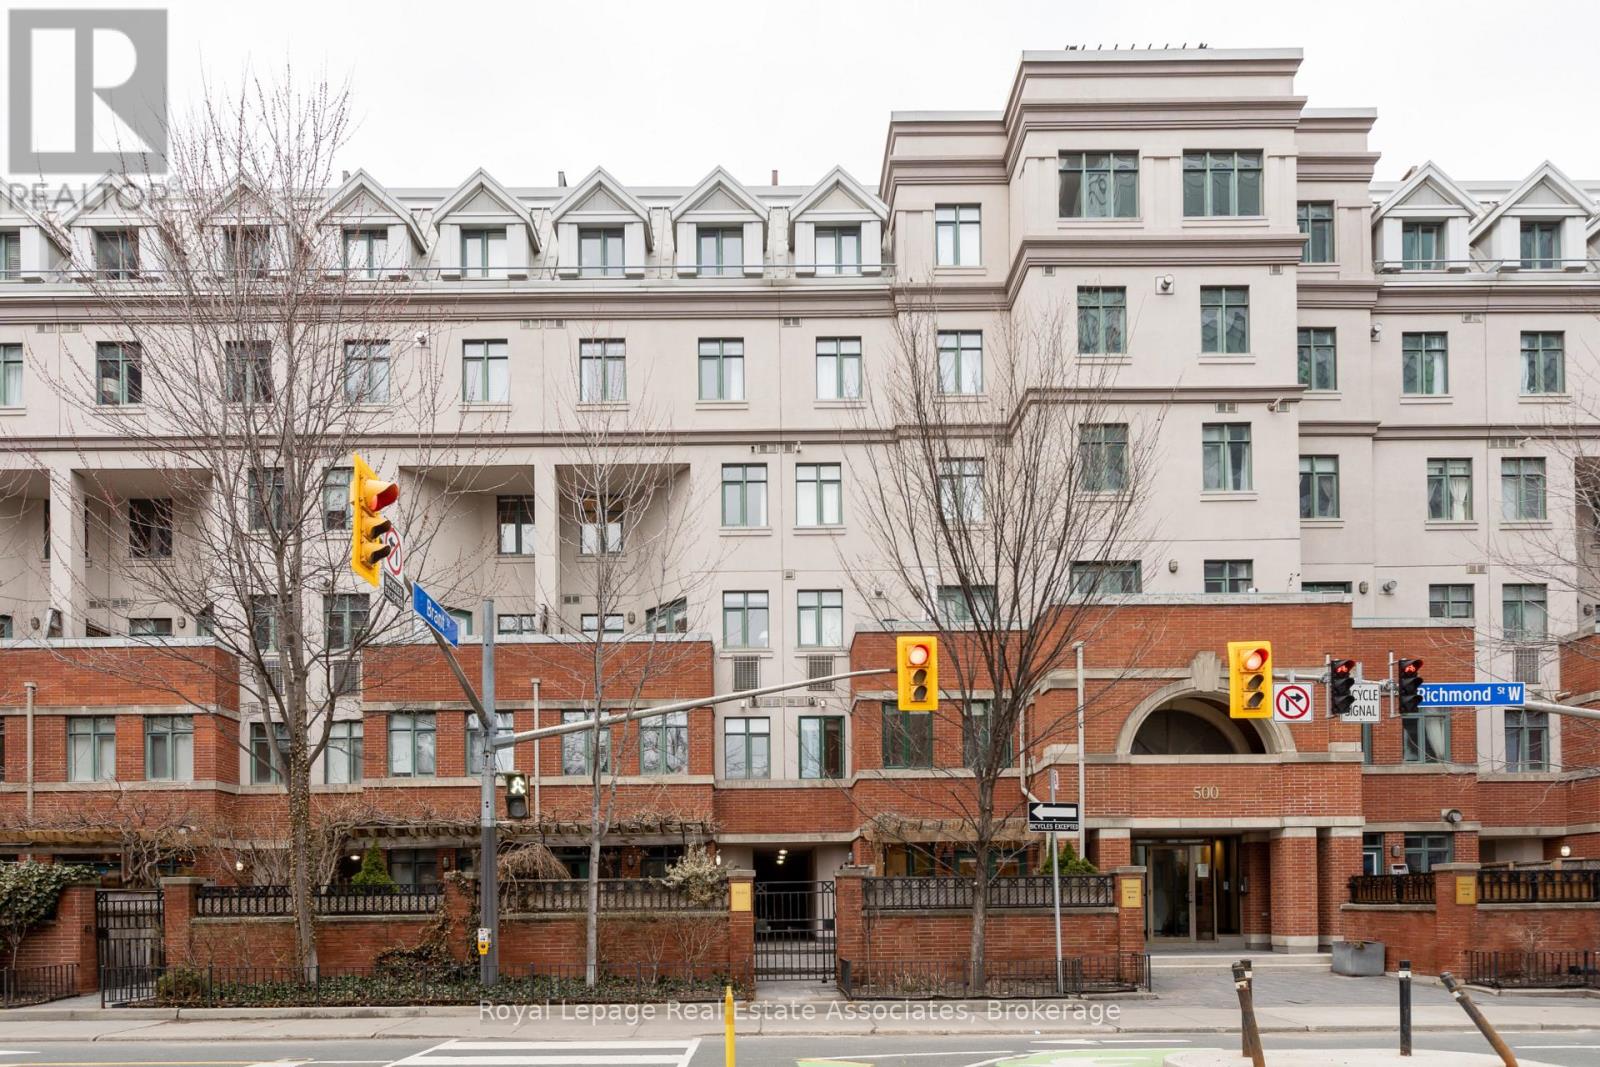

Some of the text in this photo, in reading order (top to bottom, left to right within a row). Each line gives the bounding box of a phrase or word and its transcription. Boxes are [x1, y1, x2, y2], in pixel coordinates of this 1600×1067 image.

[1351, 689, 1378, 701] CYCLE
[1417, 686, 1521, 702] Richmond St W
[1193, 786, 1219, 799] 500
[1054, 823, 1078, 831] EXCEPTED
